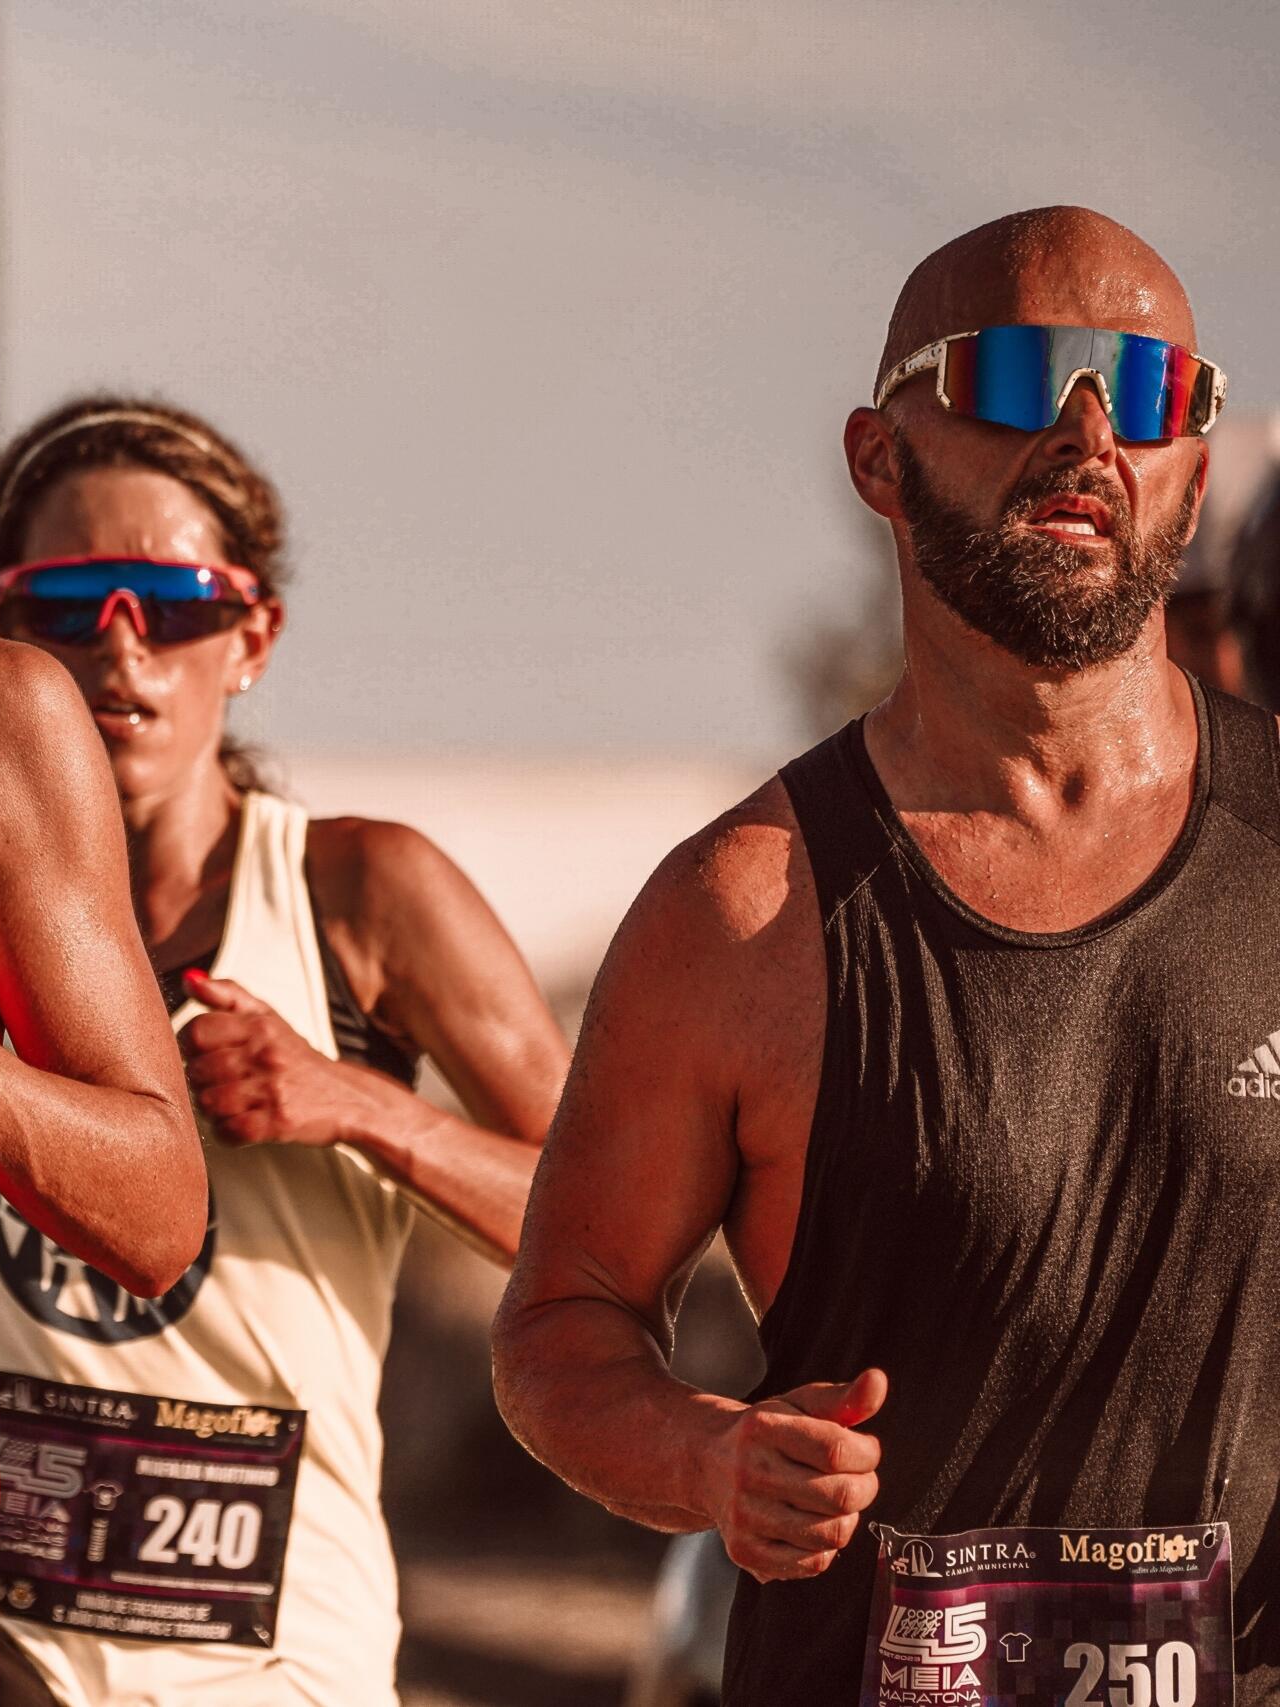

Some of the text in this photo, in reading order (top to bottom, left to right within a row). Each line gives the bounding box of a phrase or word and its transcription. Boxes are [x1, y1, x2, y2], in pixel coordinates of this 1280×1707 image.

[43, 1388, 133, 1420] SINTRA
[137, 1494, 263, 1570] 240
[945, 1542, 1030, 1567] SINTRA
[976, 1562, 1030, 1571] MUNICIPAL
[881, 1660, 982, 1690] MEIA
[1063, 1640, 1197, 1707] 250
[879, 1686, 981, 1704] MARATONA
